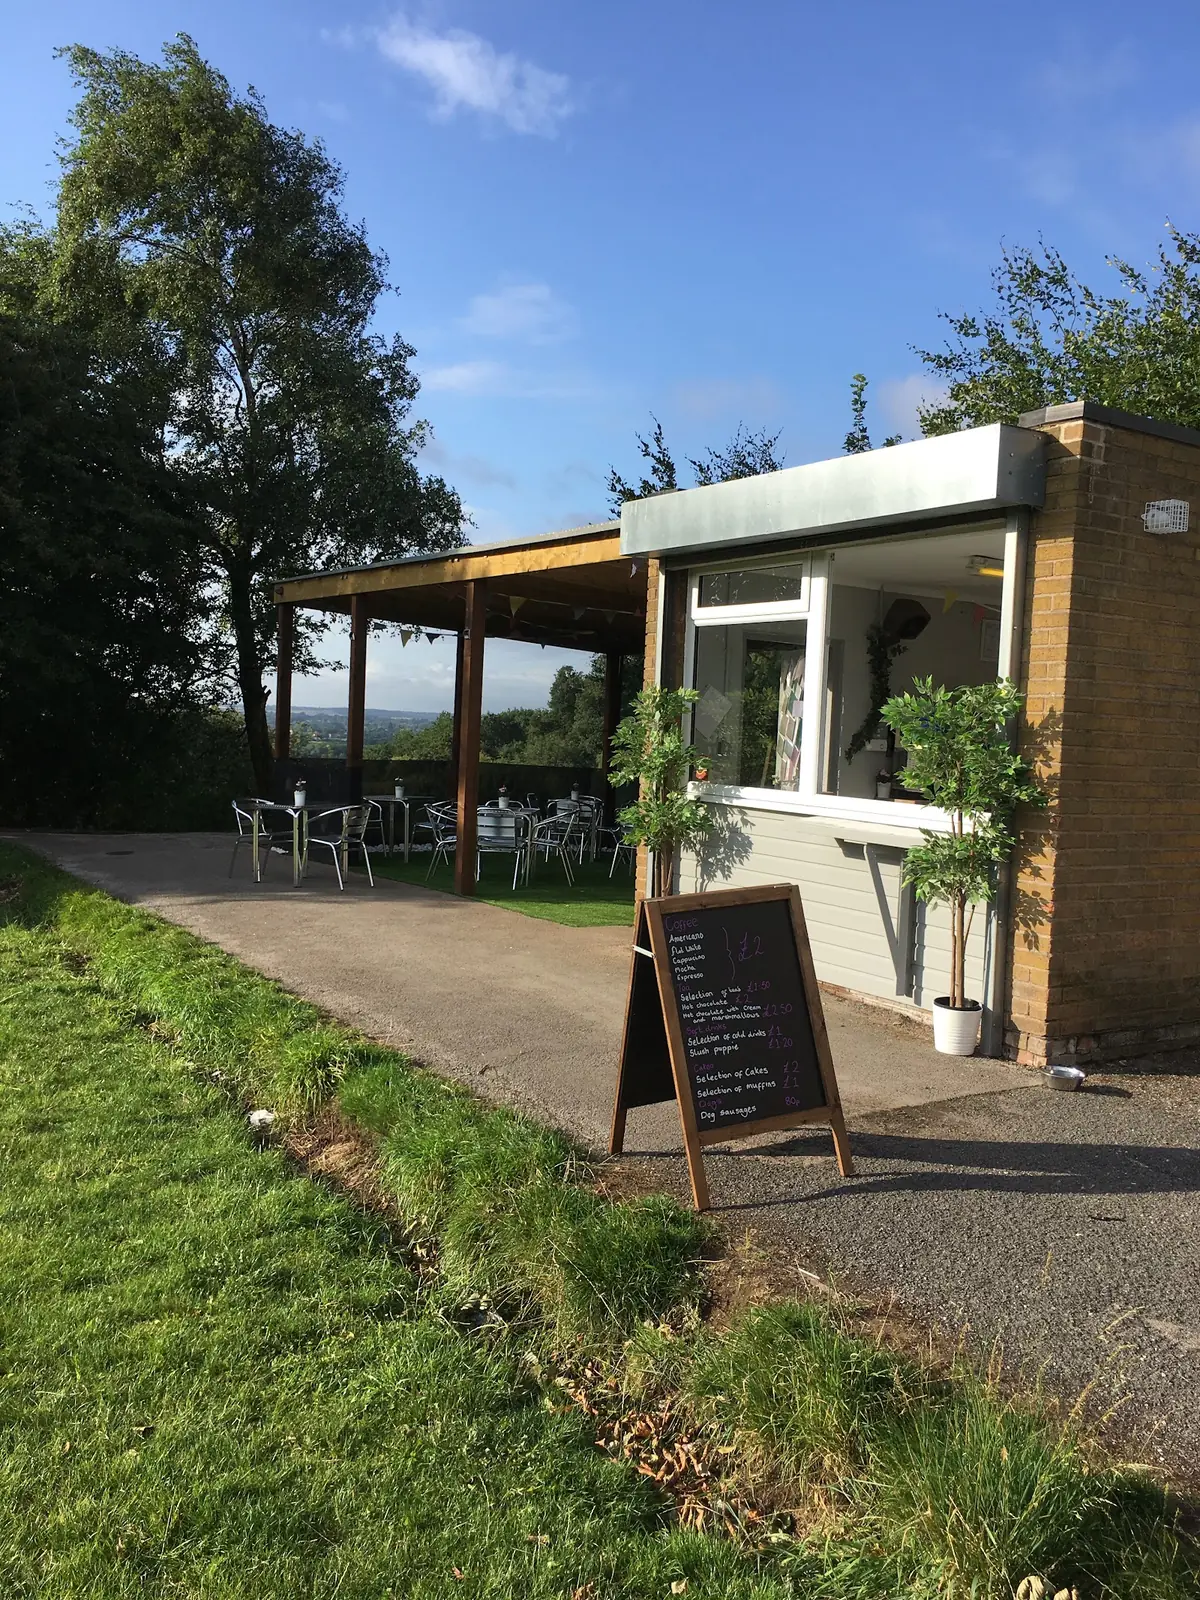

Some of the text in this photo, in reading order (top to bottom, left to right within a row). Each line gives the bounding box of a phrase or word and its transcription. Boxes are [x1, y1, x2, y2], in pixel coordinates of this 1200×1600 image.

[665, 916, 699, 931] Coffee
[669, 932, 704, 943] Americano
[675, 964, 696, 973] Mocha
[681, 989, 713, 1001] Selection
[696, 999, 728, 1009] chocolate
[696, 1008, 724, 1018] chocolate
[727, 1005, 739, 1013] with
[712, 1012, 760, 1022] marshmallows
[686, 1023, 727, 1036] Soft drinks
[687, 1033, 719, 1046] Selection
[732, 1030, 746, 1039] cold
[748, 1029, 767, 1038] drinks
[689, 1046, 710, 1057] Slush
[696, 1069, 732, 1084] Selection
[734, 1070, 743, 1080] of
[745, 1066, 769, 1077] Cakes
[697, 1085, 732, 1098] Selection
[734, 1085, 742, 1093] of
[746, 1080, 777, 1092] muffins
[700, 1105, 757, 1123] Dog sausages
